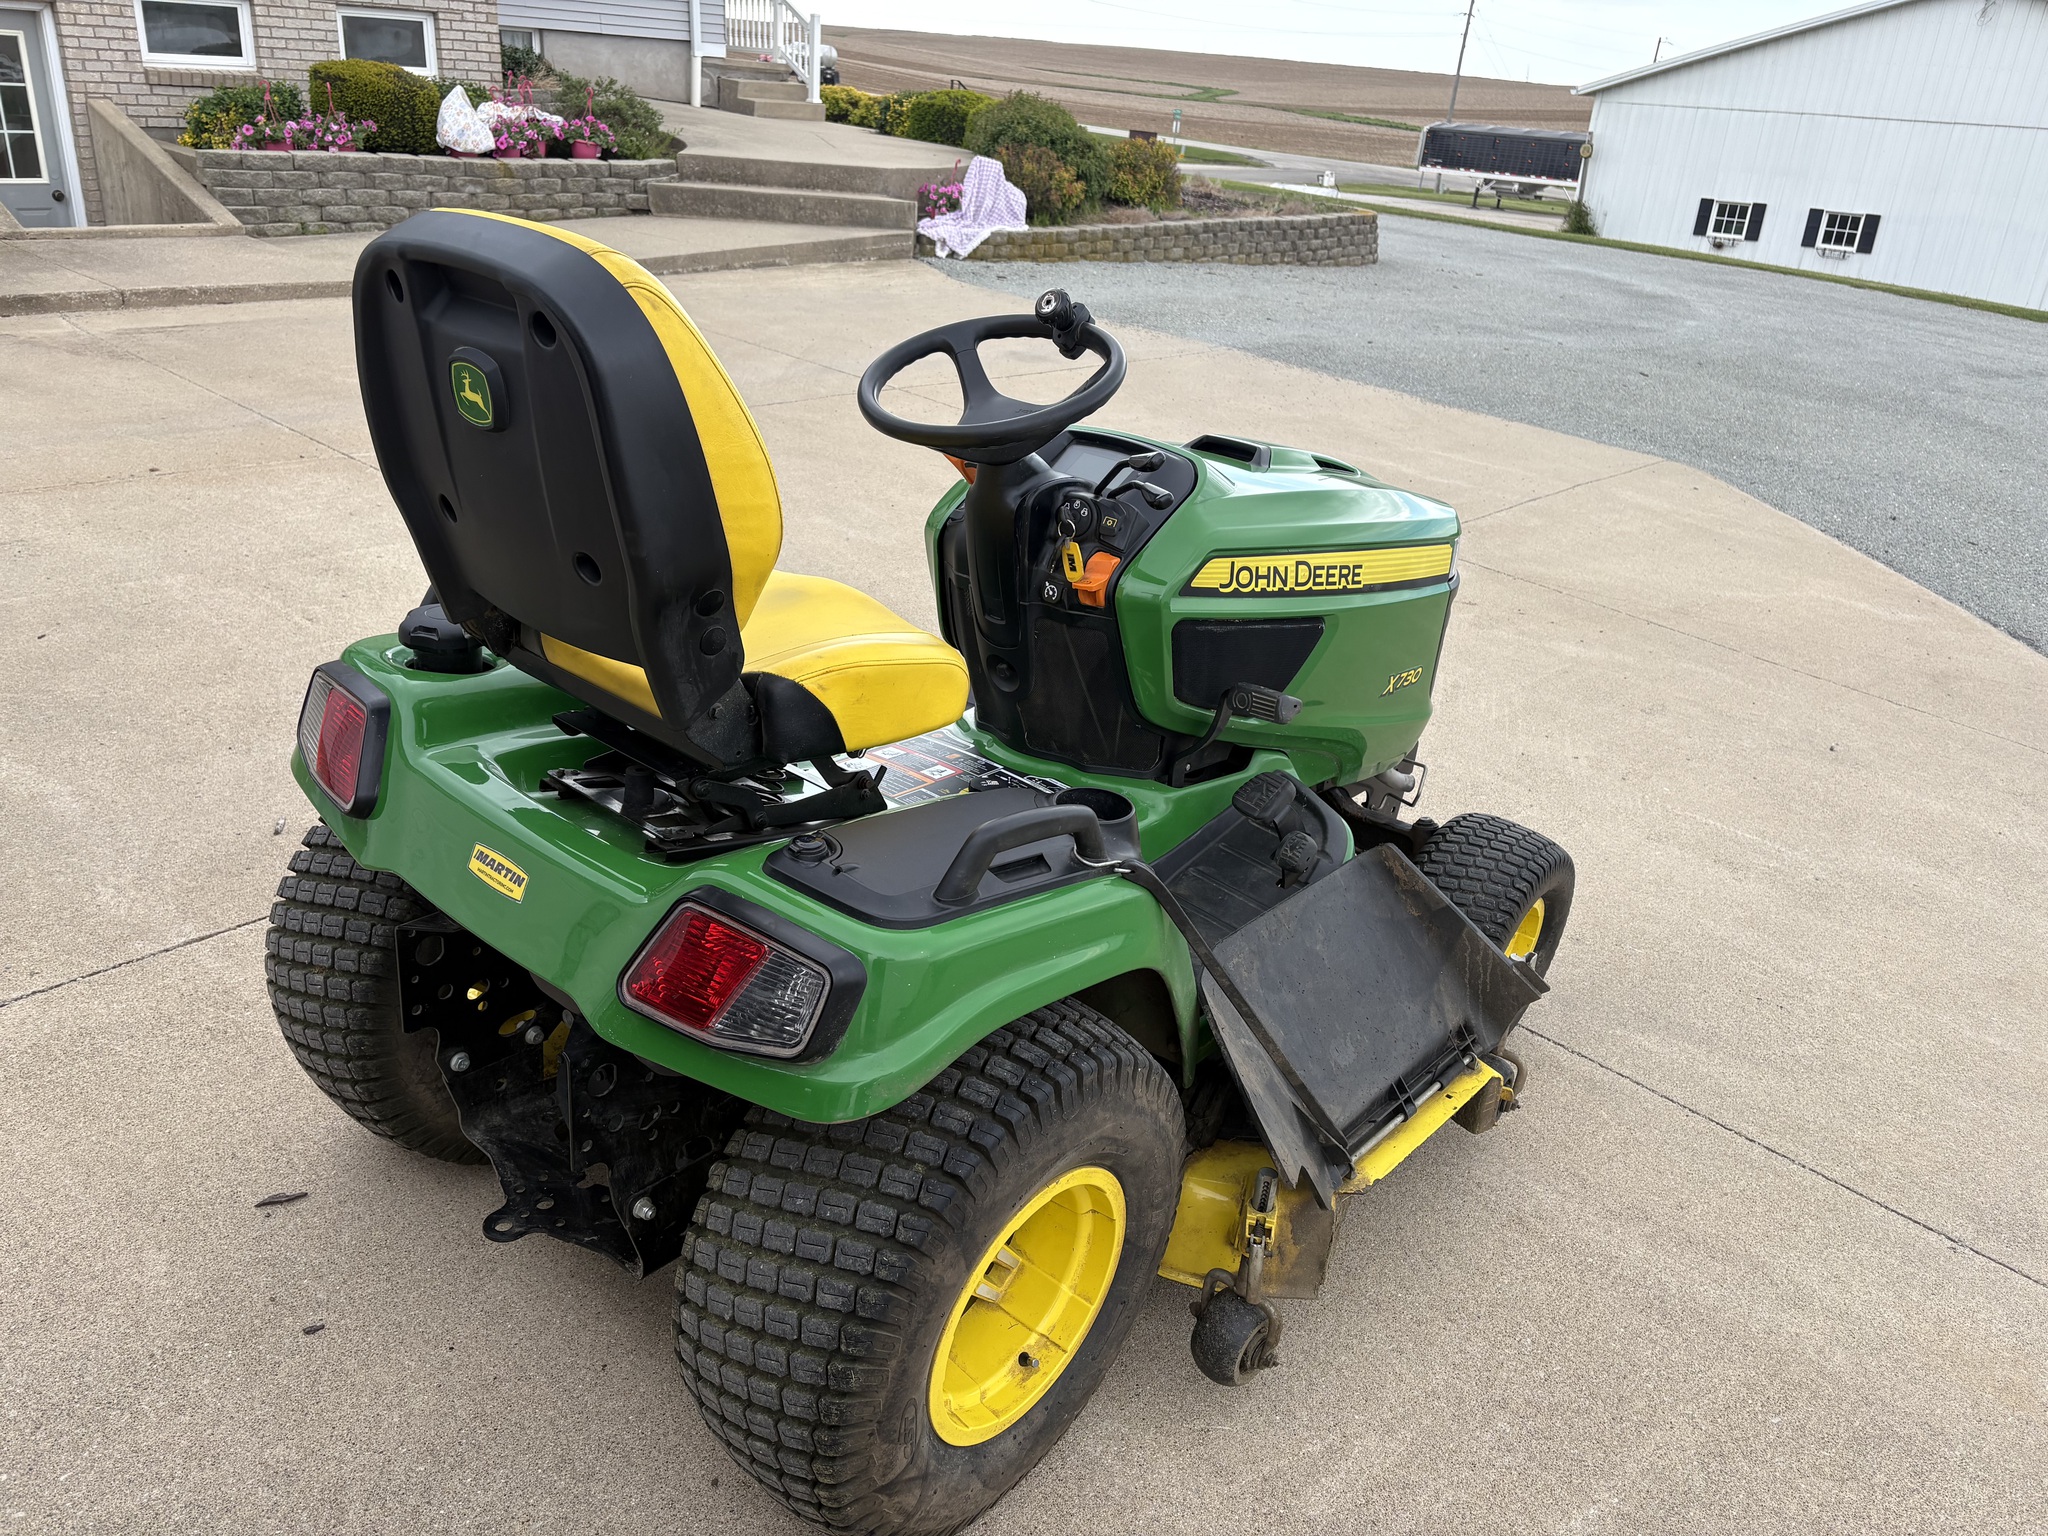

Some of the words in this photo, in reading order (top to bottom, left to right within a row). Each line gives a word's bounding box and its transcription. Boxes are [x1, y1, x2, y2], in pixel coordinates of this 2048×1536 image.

[1219, 560, 1289, 591] JOHN
[1295, 560, 1364, 589] DEERE
[1382, 666, 1423, 696] X730
[473, 849, 526, 888] MARTIN
